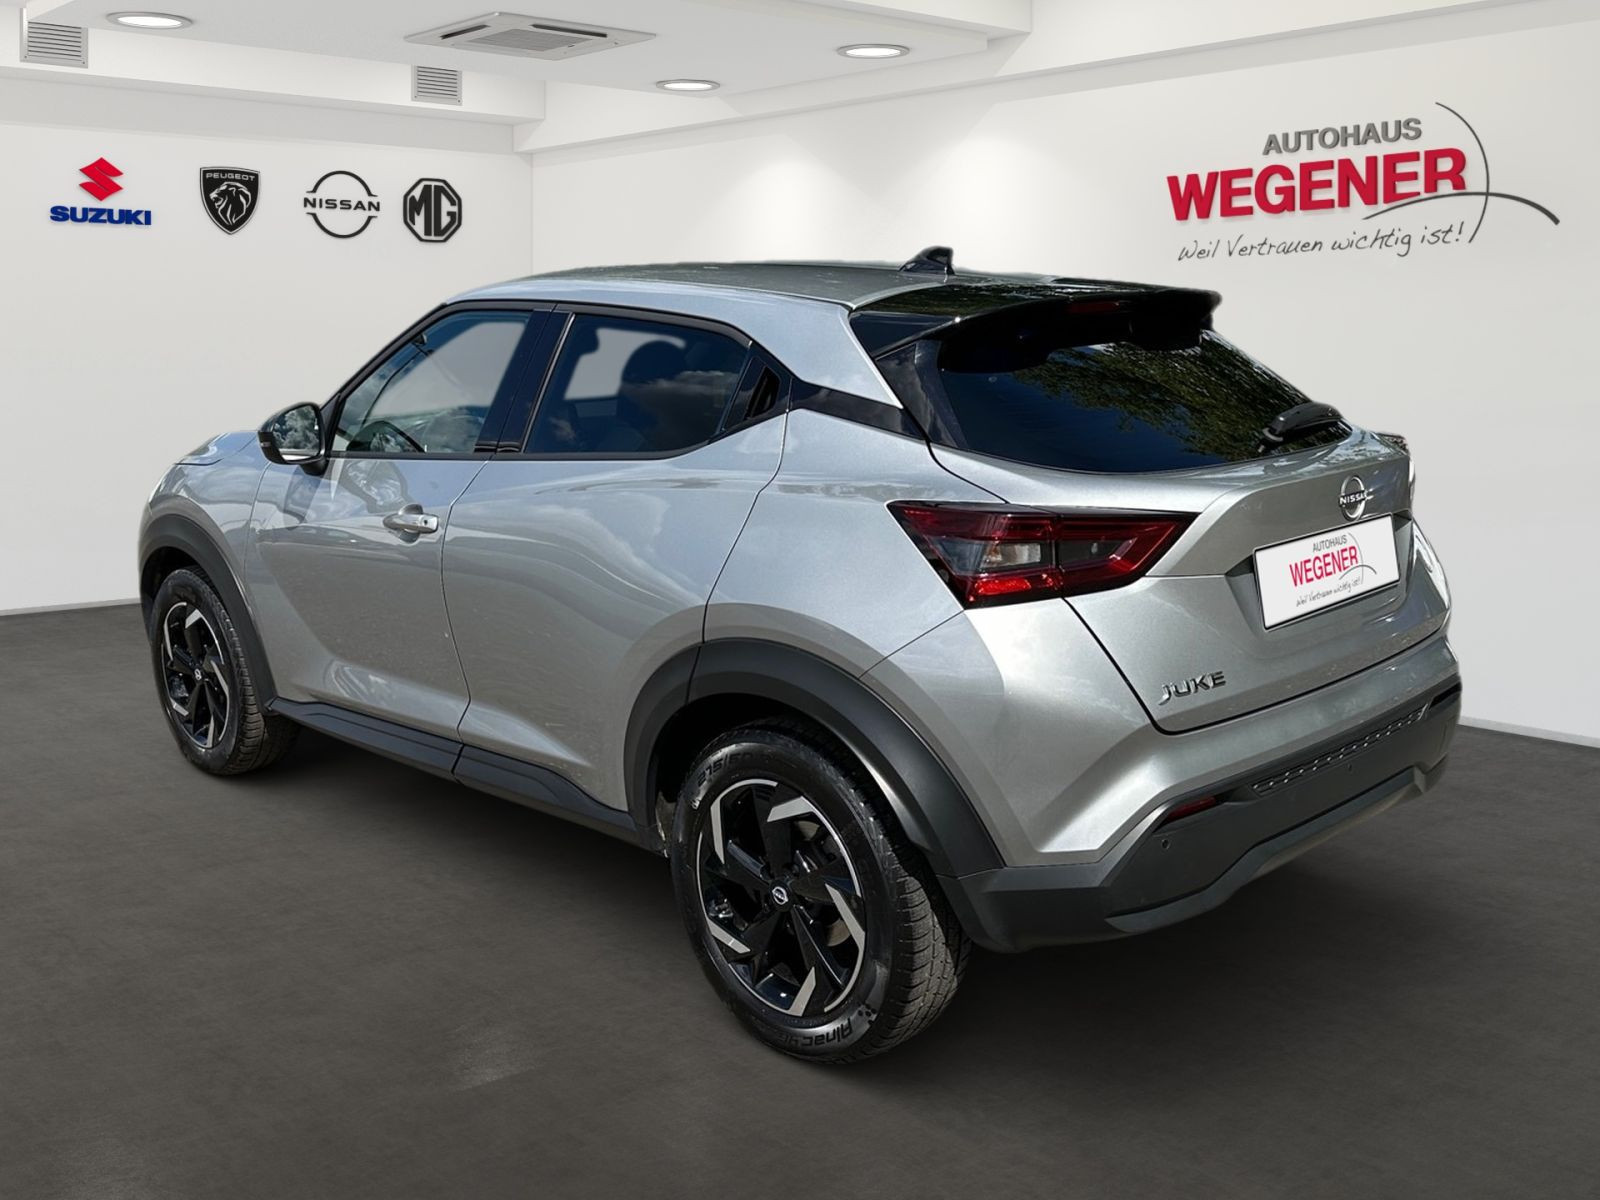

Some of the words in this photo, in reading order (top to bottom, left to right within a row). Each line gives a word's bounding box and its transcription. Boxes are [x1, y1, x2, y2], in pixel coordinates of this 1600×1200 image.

[1262, 118, 1422, 155] AUTOHAUS
[205, 171, 256, 182] PEUGEOT
[1167, 147, 1467, 221] WEGENER
[49, 205, 152, 226] SUZUKI
[303, 197, 380, 212] NISSAN
[408, 182, 458, 237] MG
[1177, 238, 1220, 261] Weil
[1227, 234, 1324, 258] Vertrauen
[1331, 226, 1412, 257] wichtig
[1420, 221, 1465, 245] ist!
[1312, 534, 1348, 553] AUTOHAUS
[1289, 545, 1359, 588] WEGENER
[1158, 670, 1227, 706] JUKE
